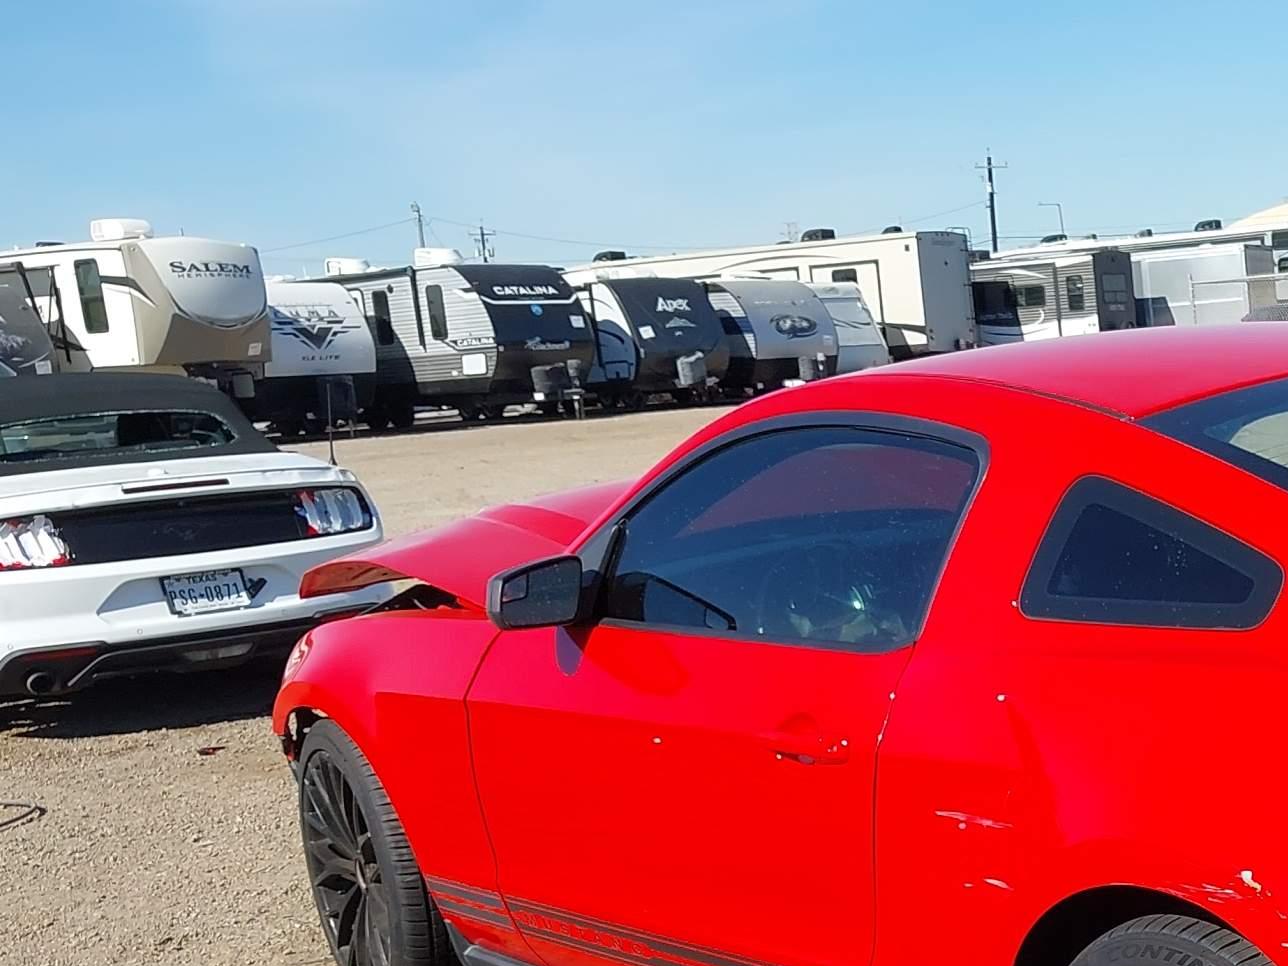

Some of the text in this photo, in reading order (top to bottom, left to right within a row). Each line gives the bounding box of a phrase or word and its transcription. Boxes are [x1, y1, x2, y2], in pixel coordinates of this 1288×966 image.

[169, 261, 251, 273] SALEM
[492, 285, 559, 296] CATALINA
[457, 337, 495, 346] CATALINA
[185, 574, 217, 584] TEXAS
